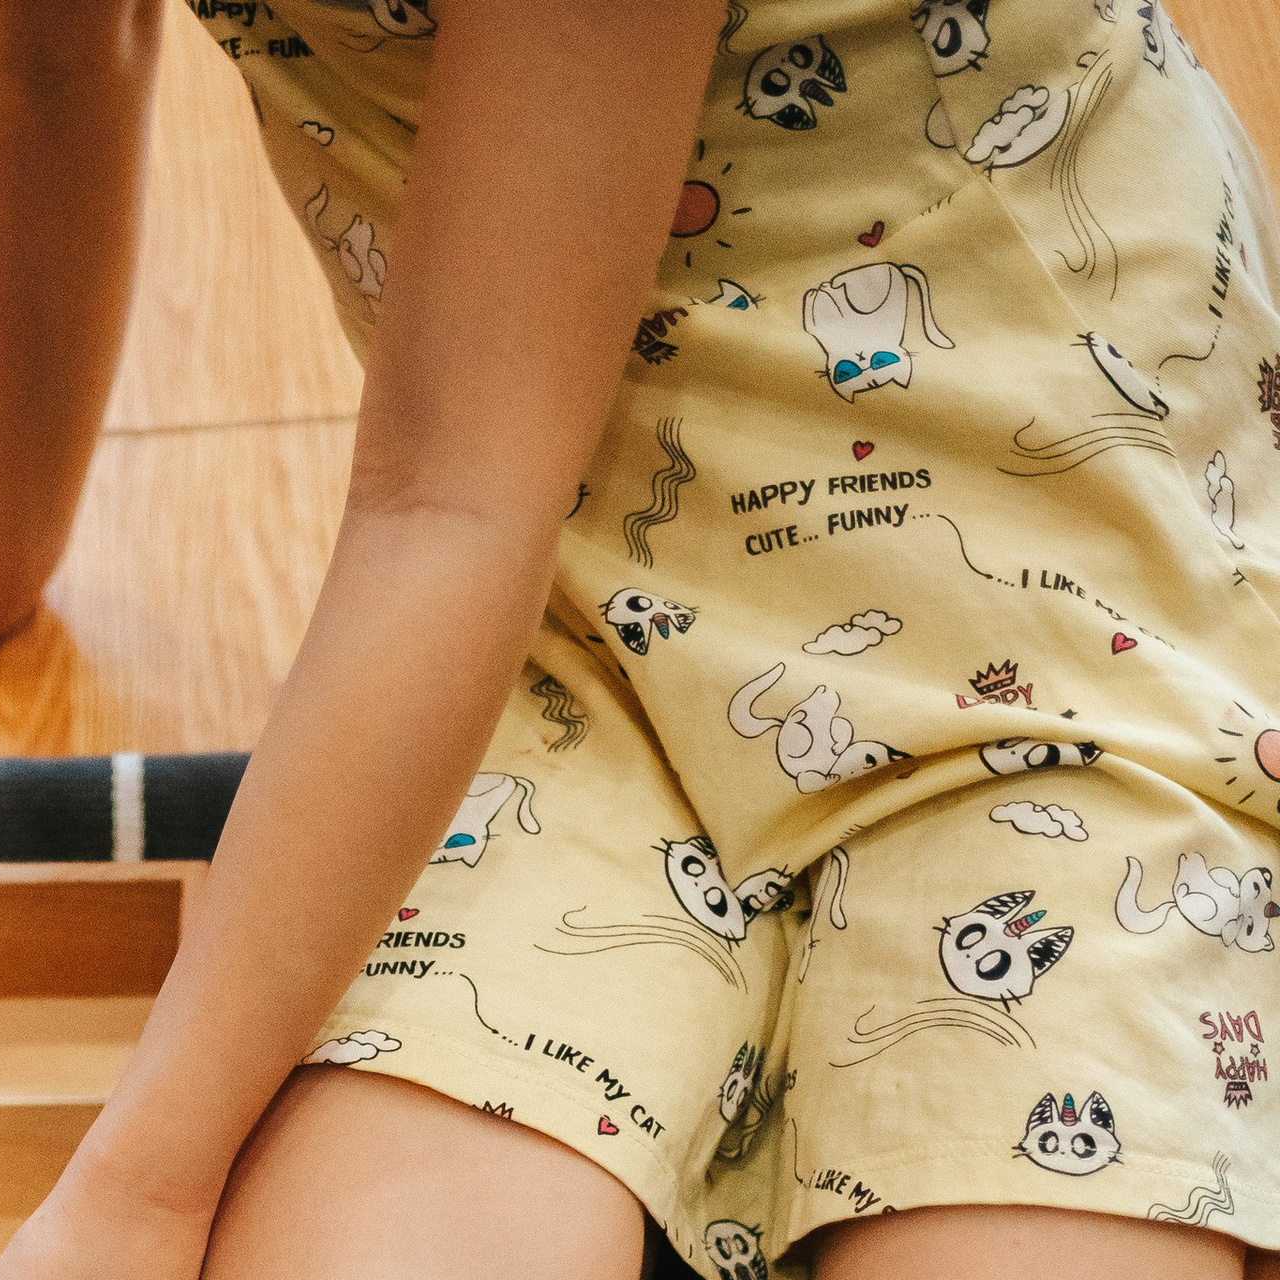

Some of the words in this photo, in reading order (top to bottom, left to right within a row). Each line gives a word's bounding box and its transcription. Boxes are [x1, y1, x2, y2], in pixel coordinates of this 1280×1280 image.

[1211, 245, 1231, 300] LIKE
[731, 479, 816, 515] HAPPY
[828, 468, 932, 495] FRIENDS
[745, 525, 819, 556] CUTE...
[827, 503, 930, 535] FUNNY...
[1040, 570, 1086, 599] LIKE
[376, 931, 466, 949] RIENDS
[360, 959, 454, 979] UNNY...
[1199, 1010, 1265, 1043] DAYS
[1214, 1055, 1268, 1082] HAPPY
[542, 1039, 595, 1073] LIKE
[595, 1068, 631, 1101] MY
[630, 1104, 666, 1139] CAT
[815, 1169, 851, 1194] LIKE
[848, 1181, 882, 1213] MY
